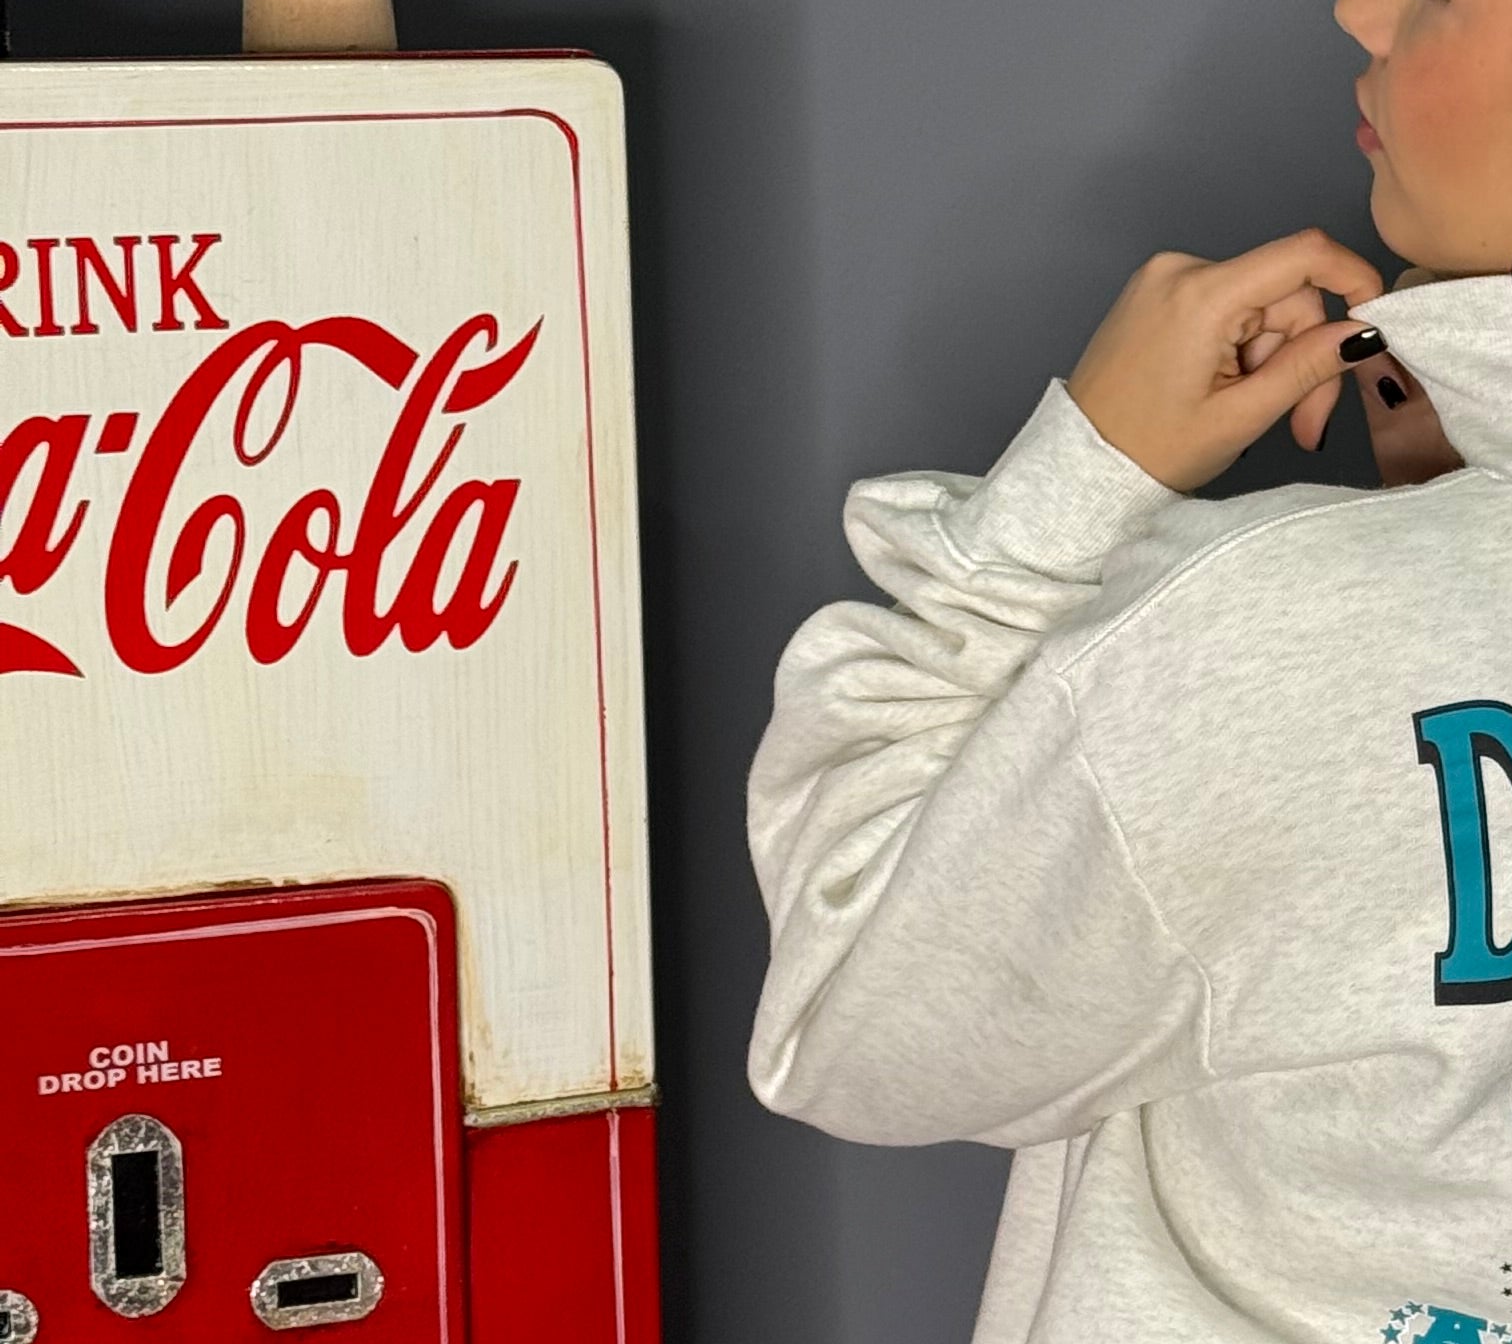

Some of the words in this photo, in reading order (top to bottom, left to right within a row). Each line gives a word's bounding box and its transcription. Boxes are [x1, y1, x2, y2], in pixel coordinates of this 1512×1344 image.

[88, 1040, 169, 1069] COIN
[38, 1067, 127, 1095] DROP
[137, 1057, 222, 1085] HERE
